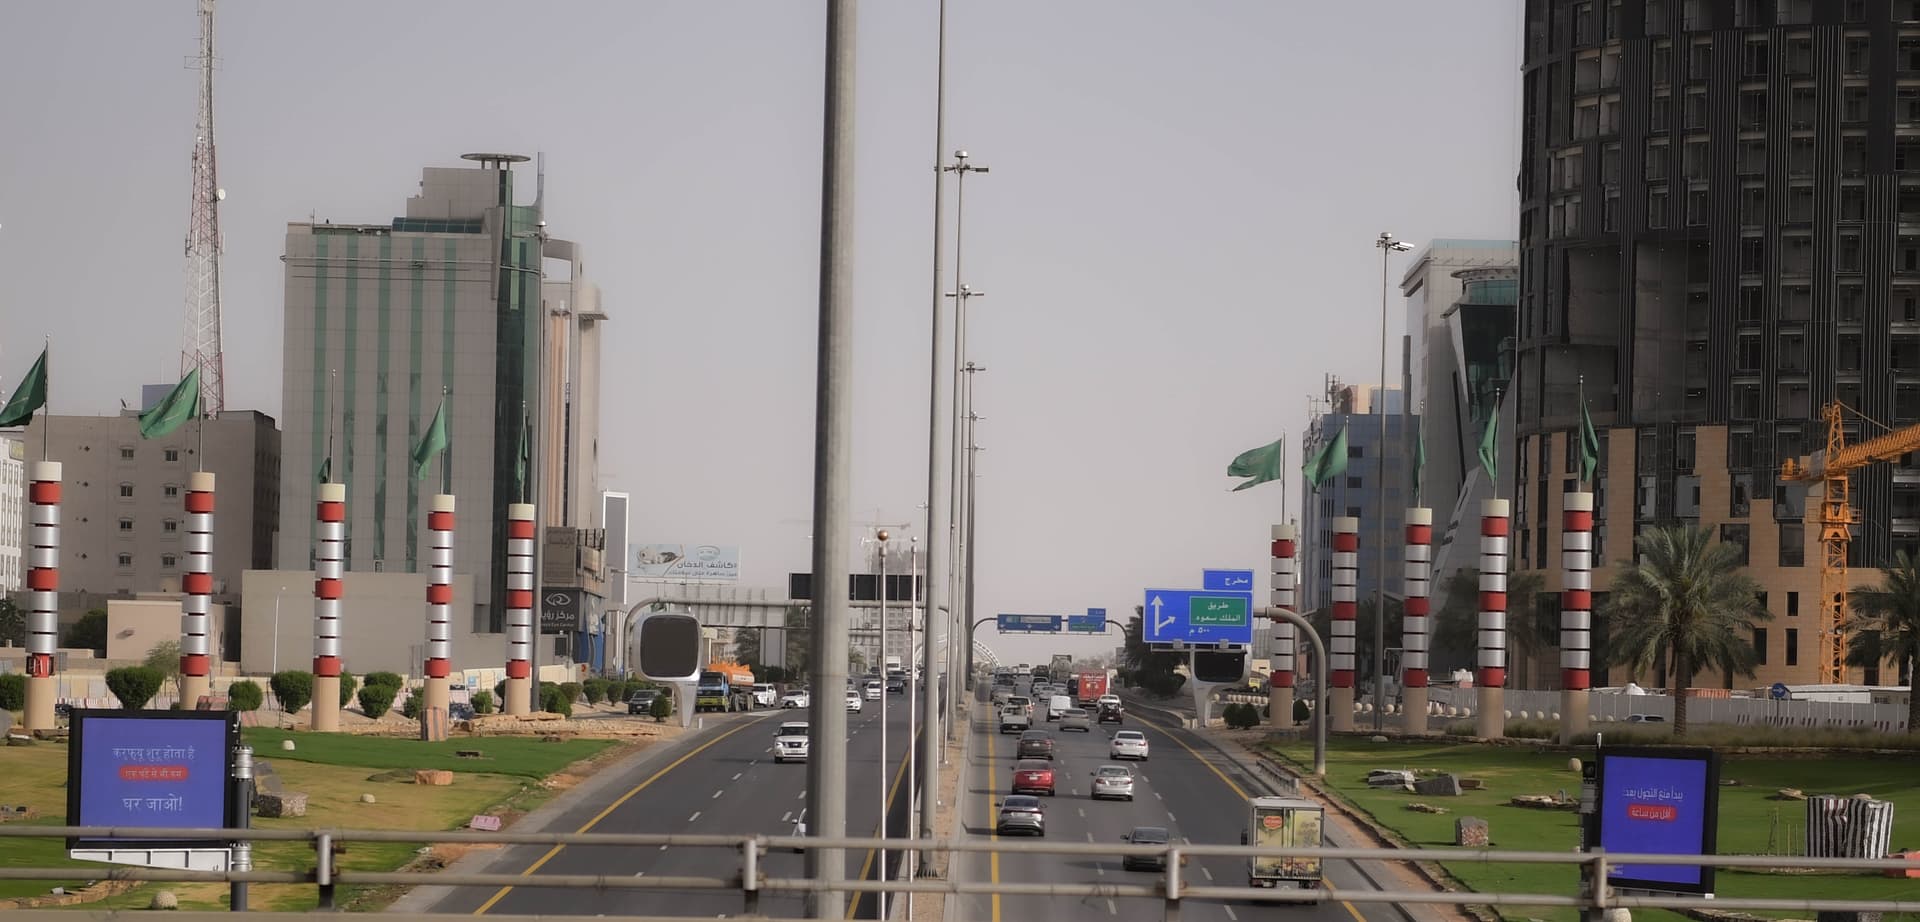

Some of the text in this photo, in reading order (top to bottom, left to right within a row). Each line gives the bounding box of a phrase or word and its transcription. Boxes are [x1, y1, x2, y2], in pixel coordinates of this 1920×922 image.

[1224, 576, 1249, 586] مخرج
[1207, 601, 1229, 610] طريق
[555, 609, 575, 621] مركز
[1196, 613, 1241, 623] الملك سعود
[1637, 787, 1658, 801] التجول
[1658, 789, 1670, 801] منع
[122, 793, 183, 812] घर जाओ!
[1631, 805, 1671, 819] أقل من ساعة
